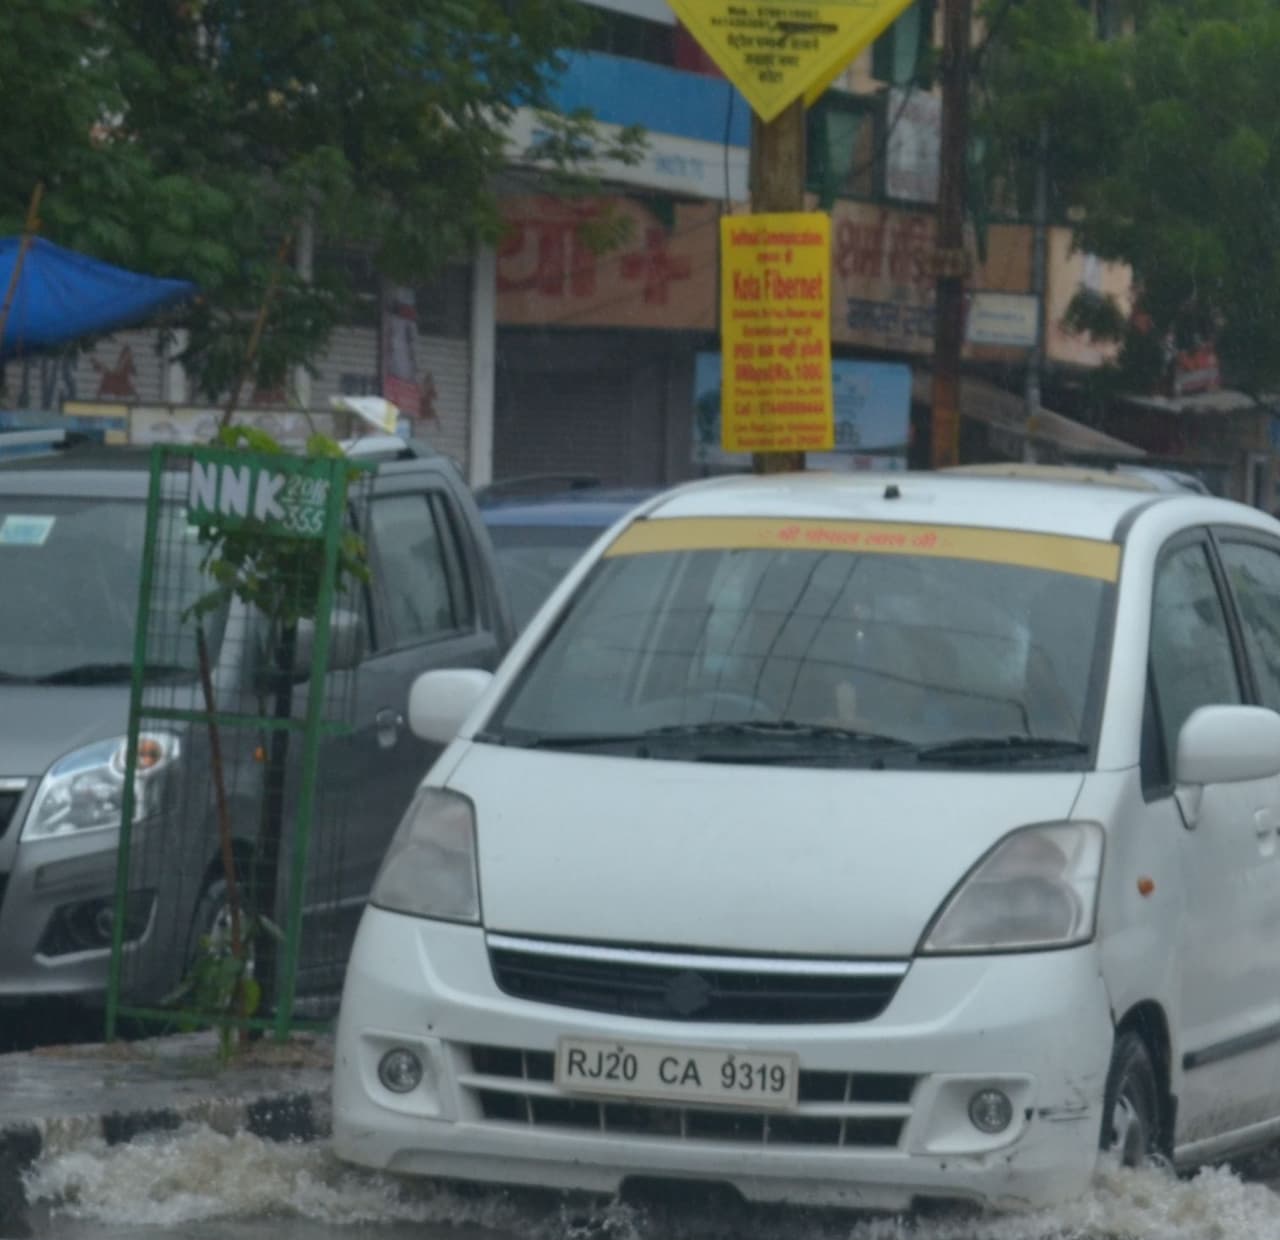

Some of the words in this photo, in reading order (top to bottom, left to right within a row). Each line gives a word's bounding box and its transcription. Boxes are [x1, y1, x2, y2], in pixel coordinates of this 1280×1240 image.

[733, 270, 761, 300] Kota
[763, 268, 824, 300] Fibernet
[190, 460, 286, 524] NNK
[567, 1048, 638, 1082] RJ20
[658, 1056, 703, 1087] CA
[720, 1060, 786, 1093] 9319
